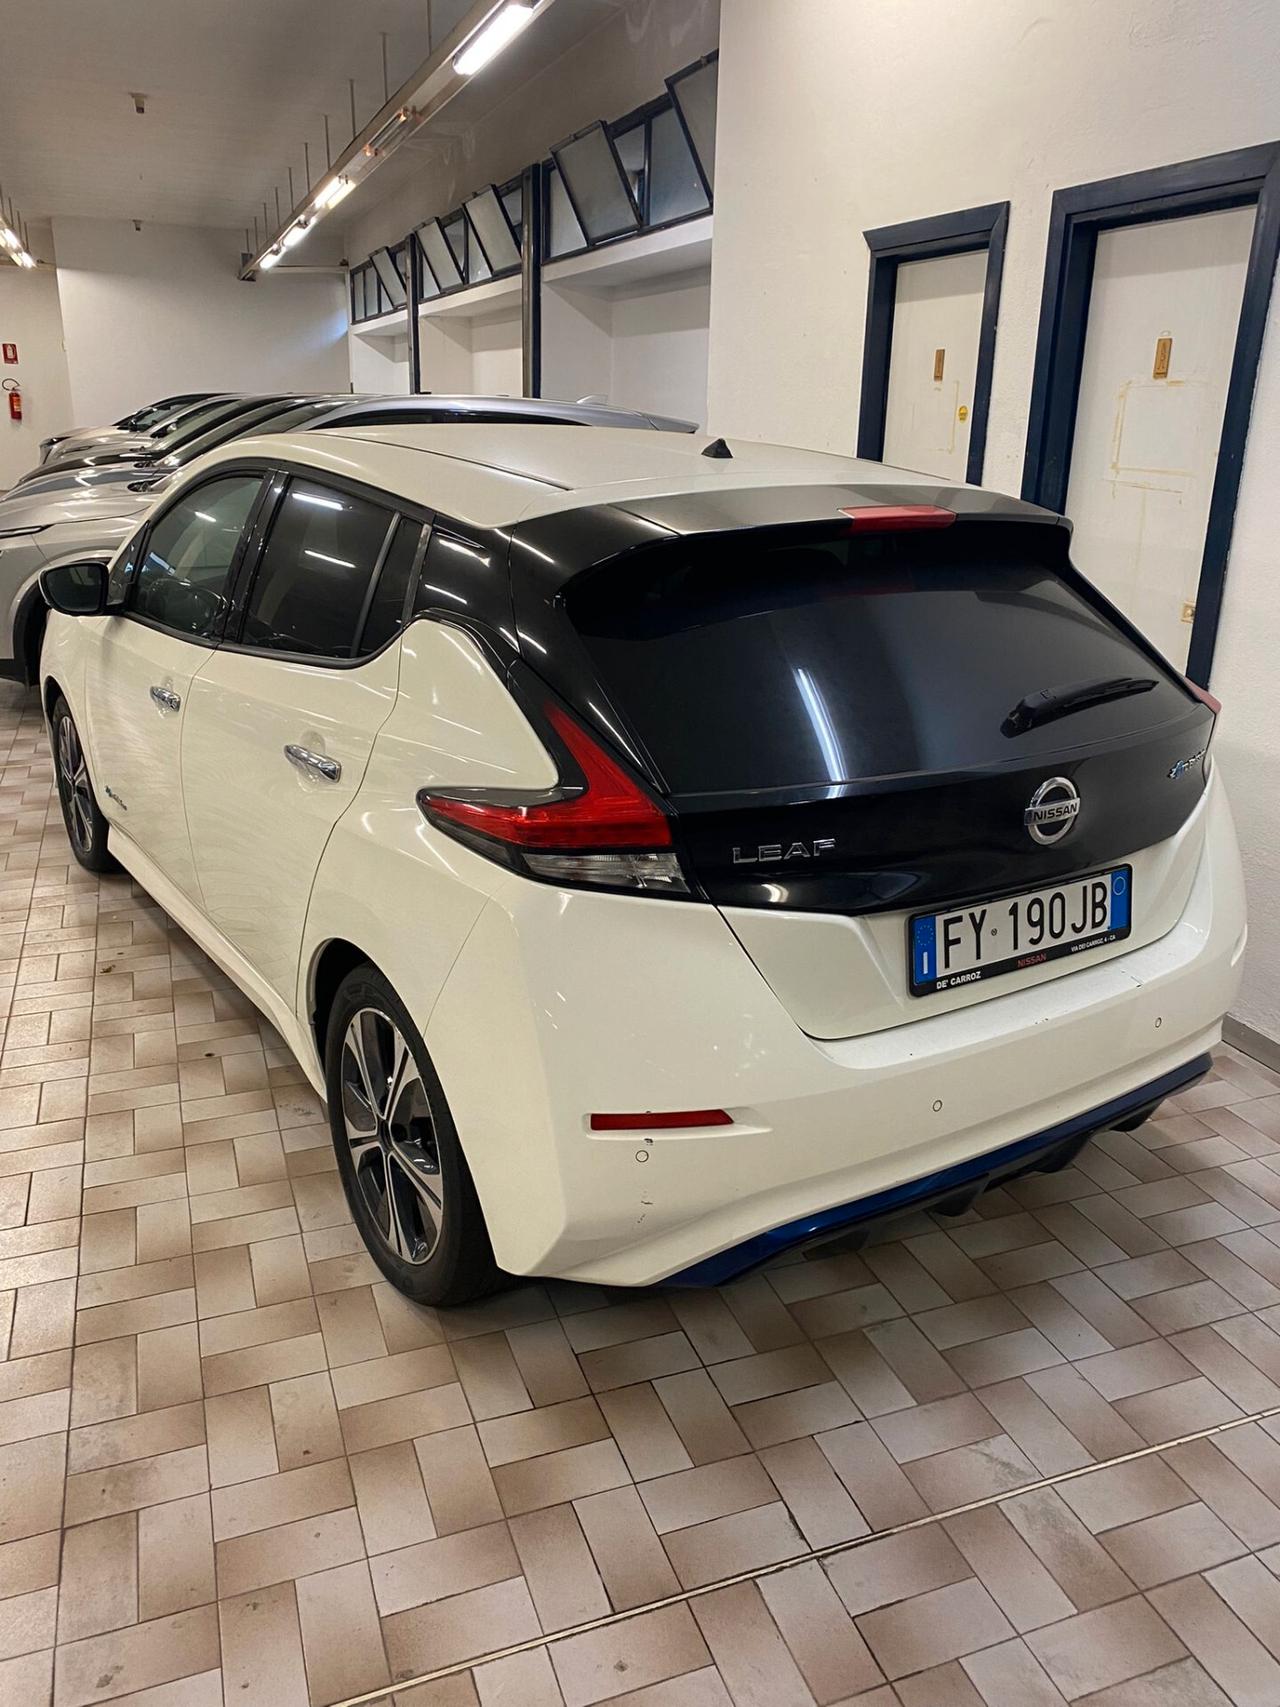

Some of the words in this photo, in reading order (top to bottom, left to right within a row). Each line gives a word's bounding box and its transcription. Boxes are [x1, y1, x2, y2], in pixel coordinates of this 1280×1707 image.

[1034, 803, 1077, 821] NISSAN
[733, 838, 835, 864] LEAF
[943, 908, 987, 969] FY
[1017, 953, 1047, 968] NISSAN
[936, 979, 949, 990] DE'
[950, 971, 981, 986] CARROZ
